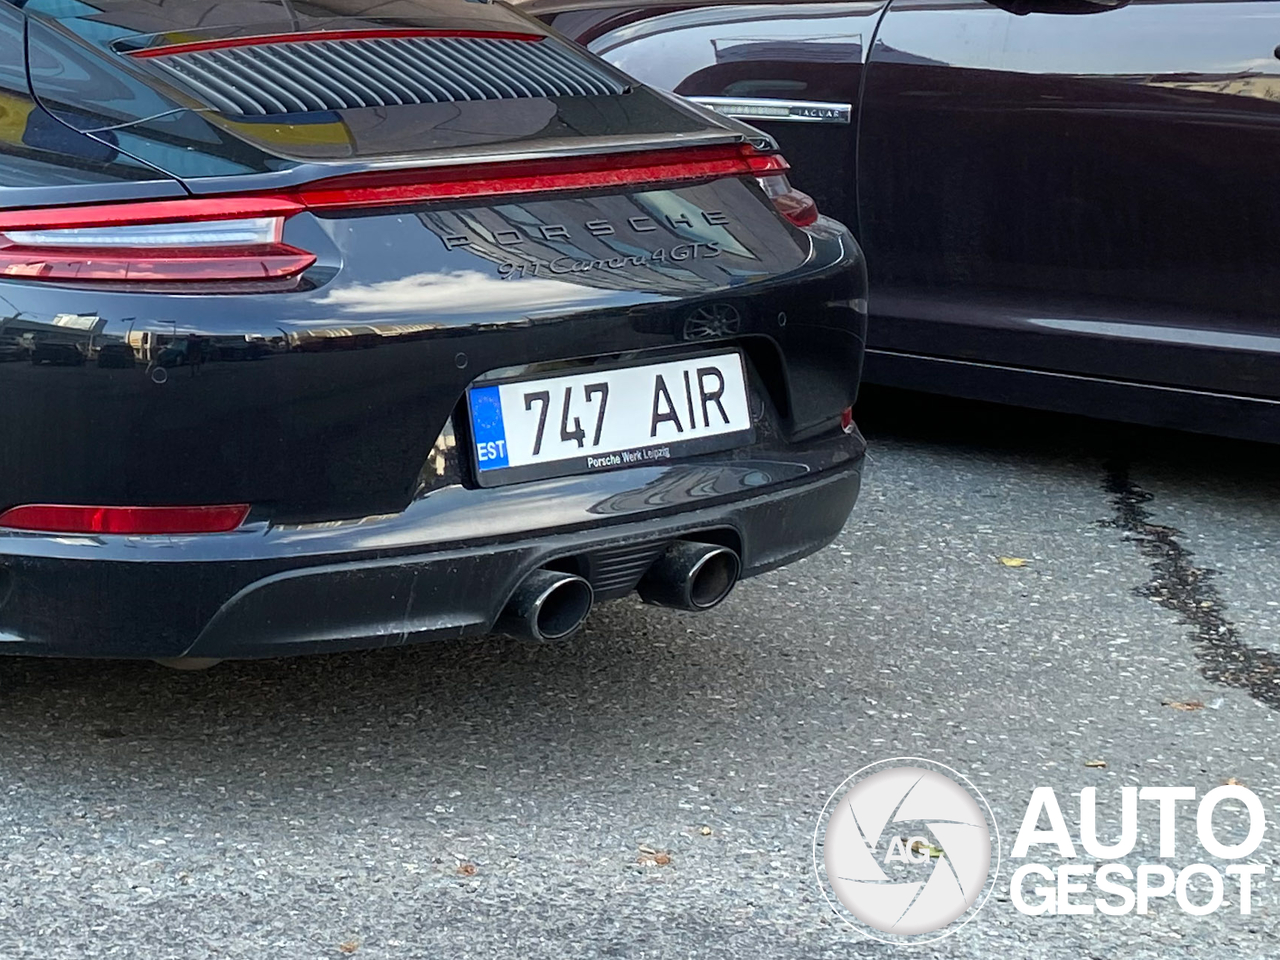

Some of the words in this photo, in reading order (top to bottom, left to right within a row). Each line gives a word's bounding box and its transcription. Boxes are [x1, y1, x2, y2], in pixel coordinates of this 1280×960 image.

[442, 210, 729, 251] PORSCHE
[497, 260, 541, 280] 911
[549, 254, 647, 276] Carrera
[523, 382, 609, 456] 747
[650, 366, 730, 437] AIR
[477, 440, 506, 461] EST
[587, 454, 621, 468] Porsche
[622, 451, 642, 464] Werk
[643, 446, 671, 462] Leipzig
